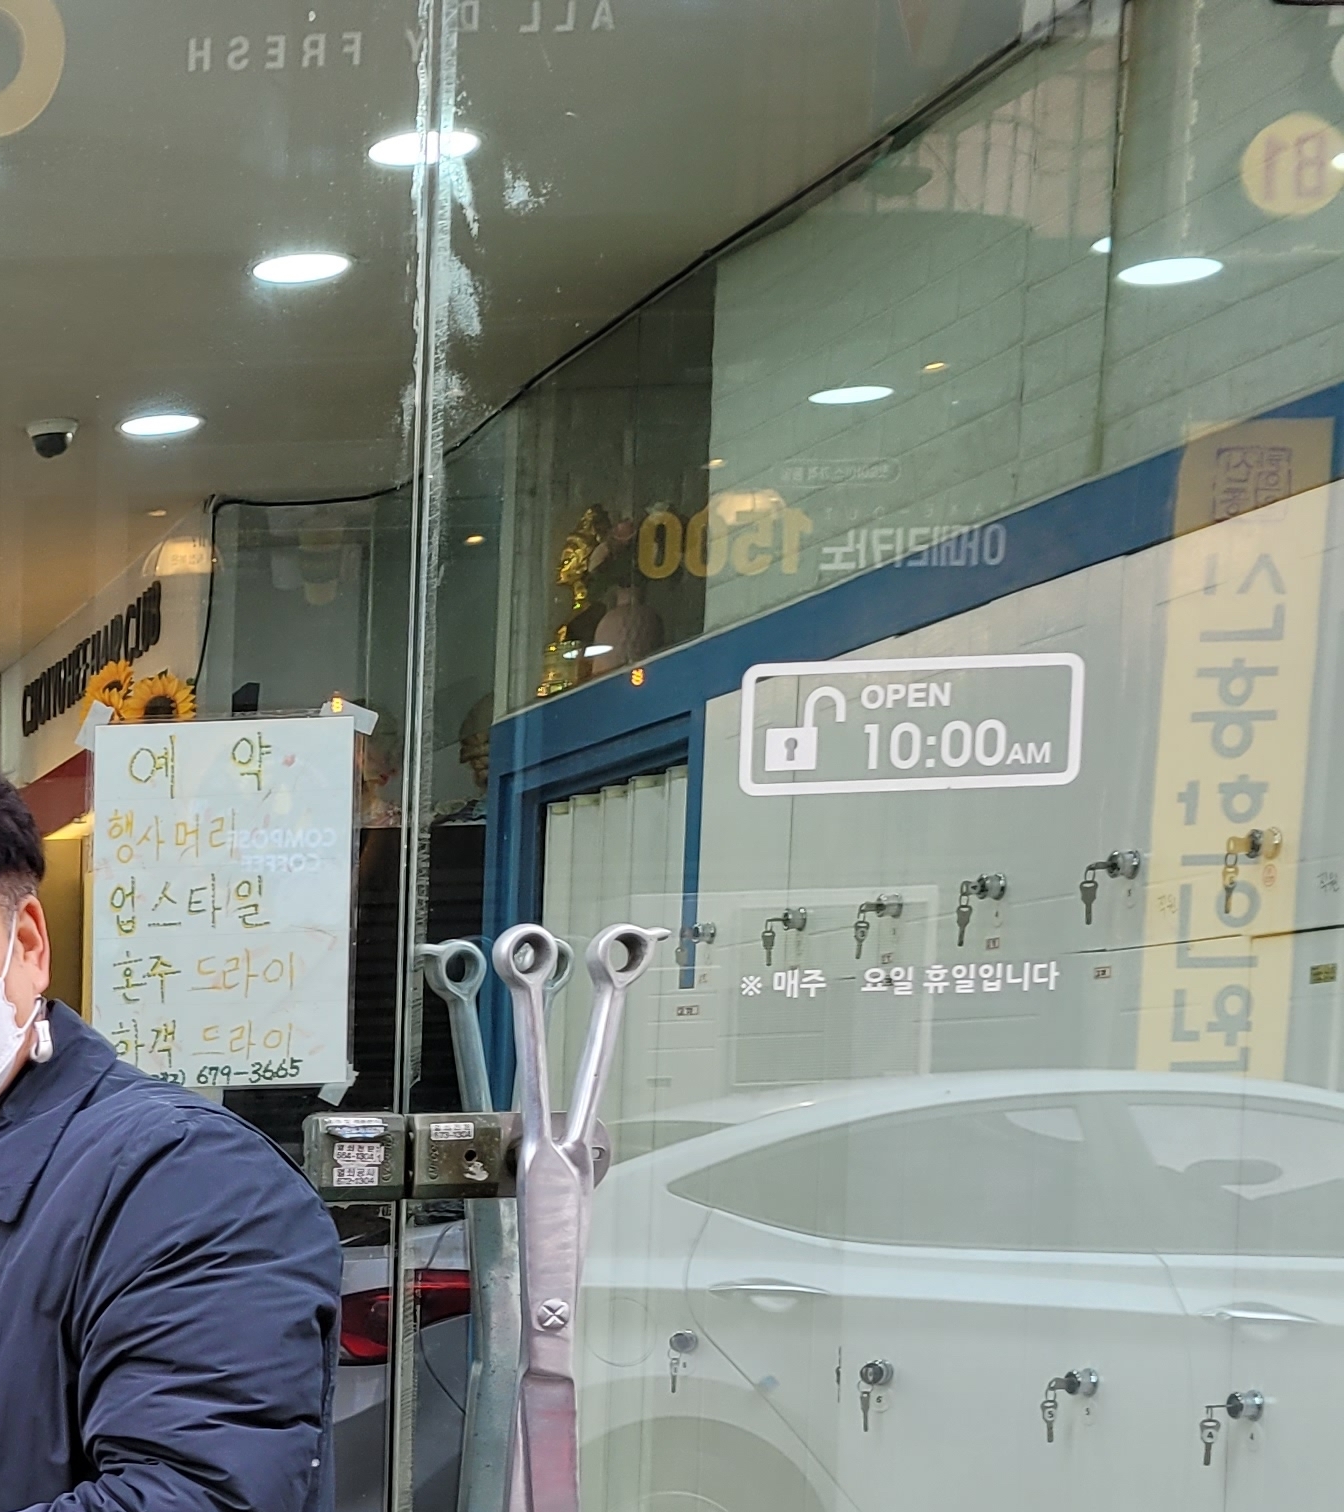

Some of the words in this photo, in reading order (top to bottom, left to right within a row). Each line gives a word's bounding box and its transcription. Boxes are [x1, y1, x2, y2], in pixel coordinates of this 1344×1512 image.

[861, 682, 952, 710] OPEN
[110, 873, 271, 936] 업스타일
[772, 969, 828, 998] 매주
[861, 966, 914, 996] 요일
[923, 960, 1060, 995] 휴일입니다
[196, 1057, 304, 1087] 679-3665
